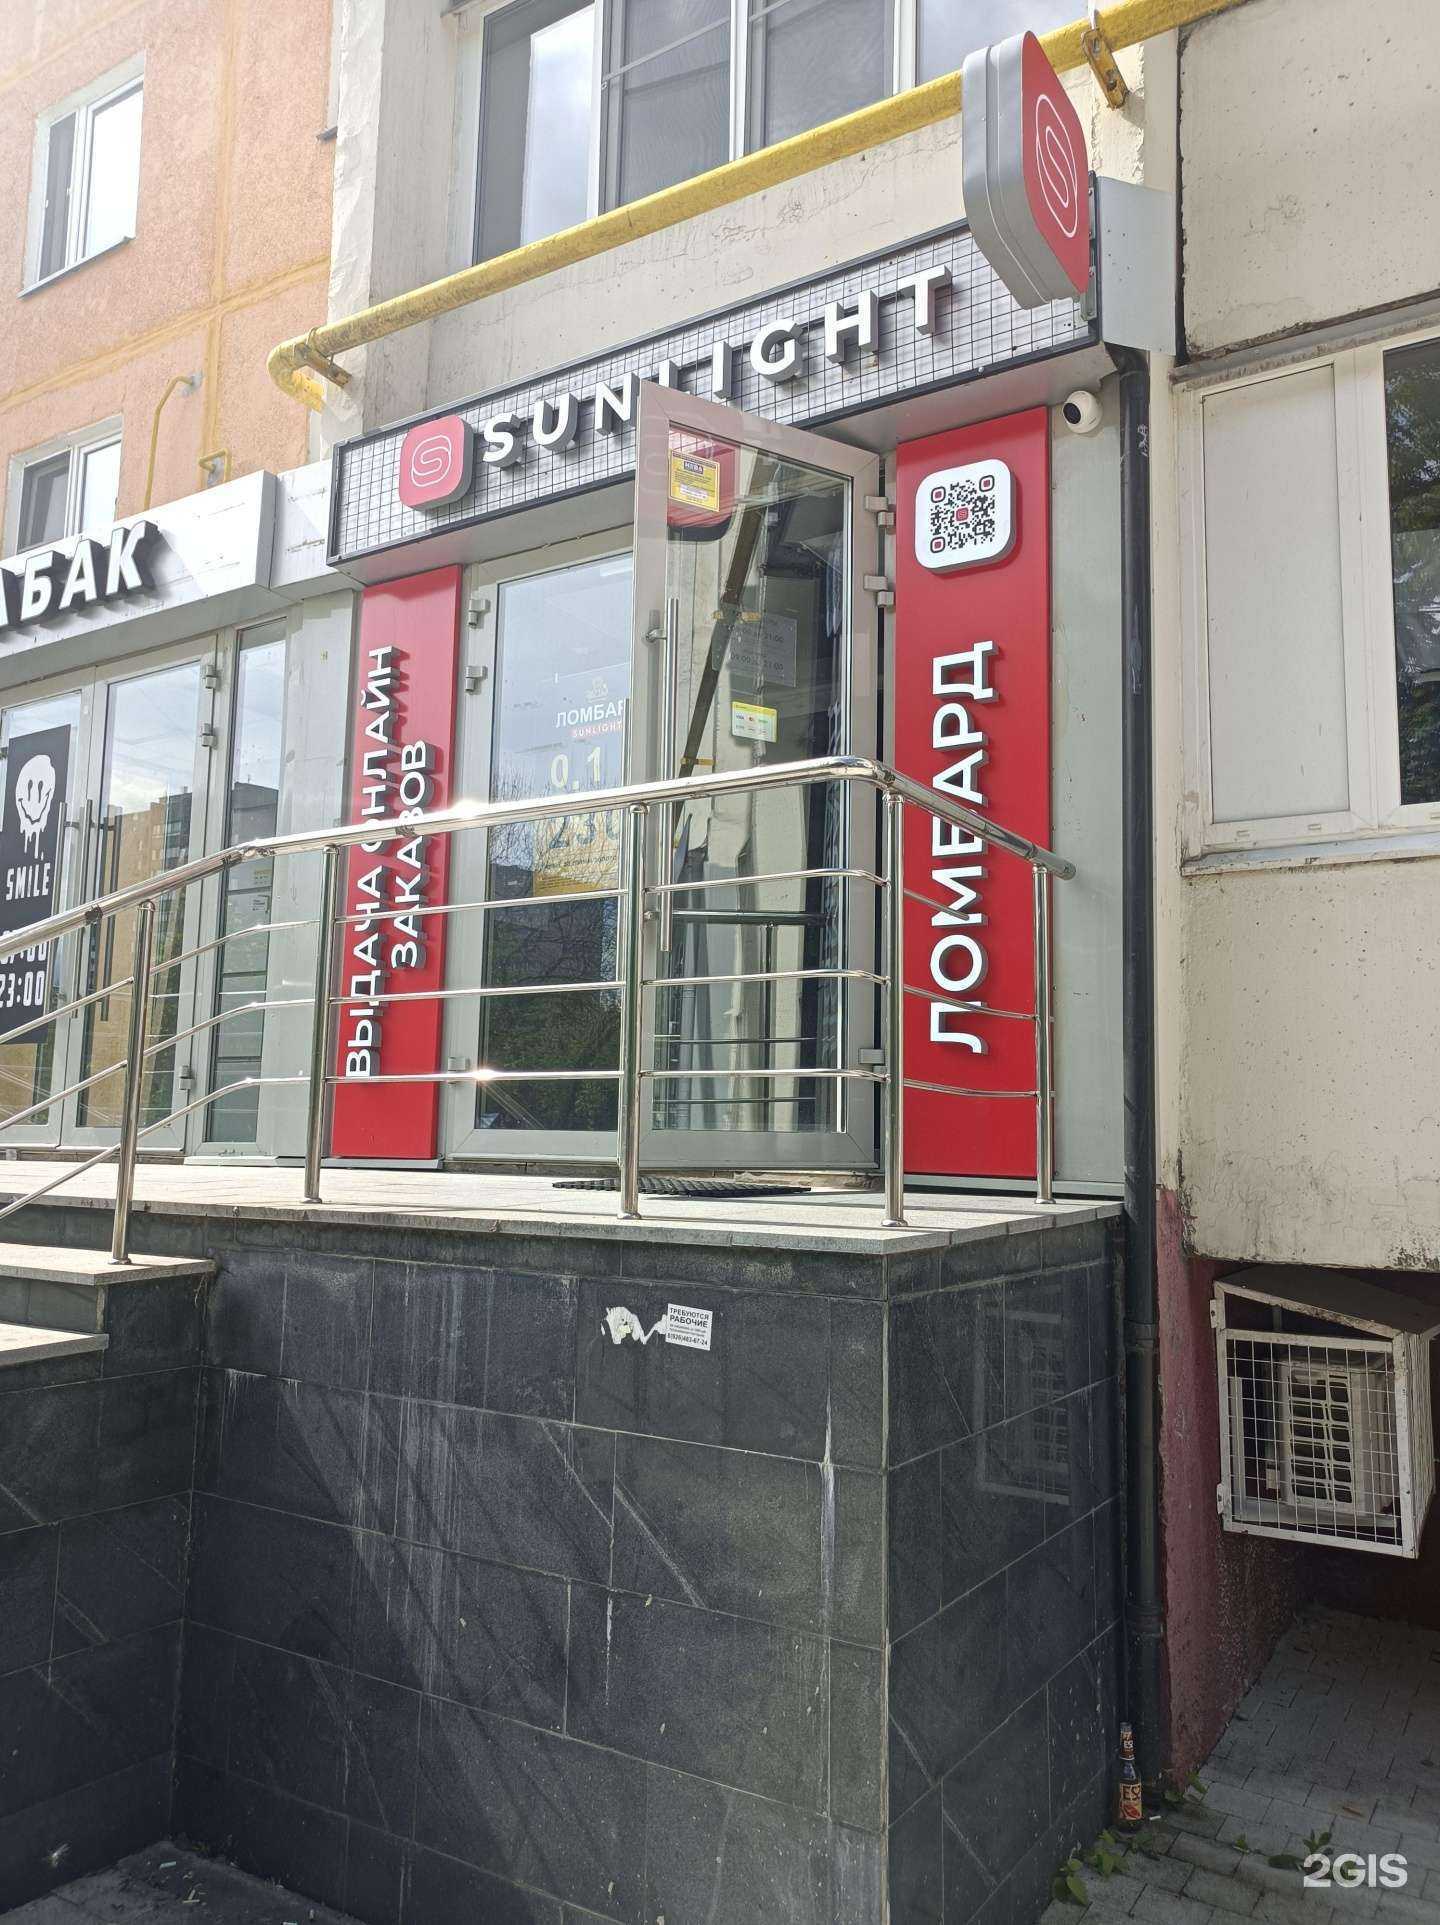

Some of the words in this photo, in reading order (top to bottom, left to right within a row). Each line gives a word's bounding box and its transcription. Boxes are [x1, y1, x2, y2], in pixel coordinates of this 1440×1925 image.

[6, 862, 50, 900] SMILE
[346, 865, 383, 1077] ВЫДАЧА
[669, 1307, 709, 1320] ТРЕБУЮТСЯ
[669, 1315, 708, 1328] РАБОЧИЕ
